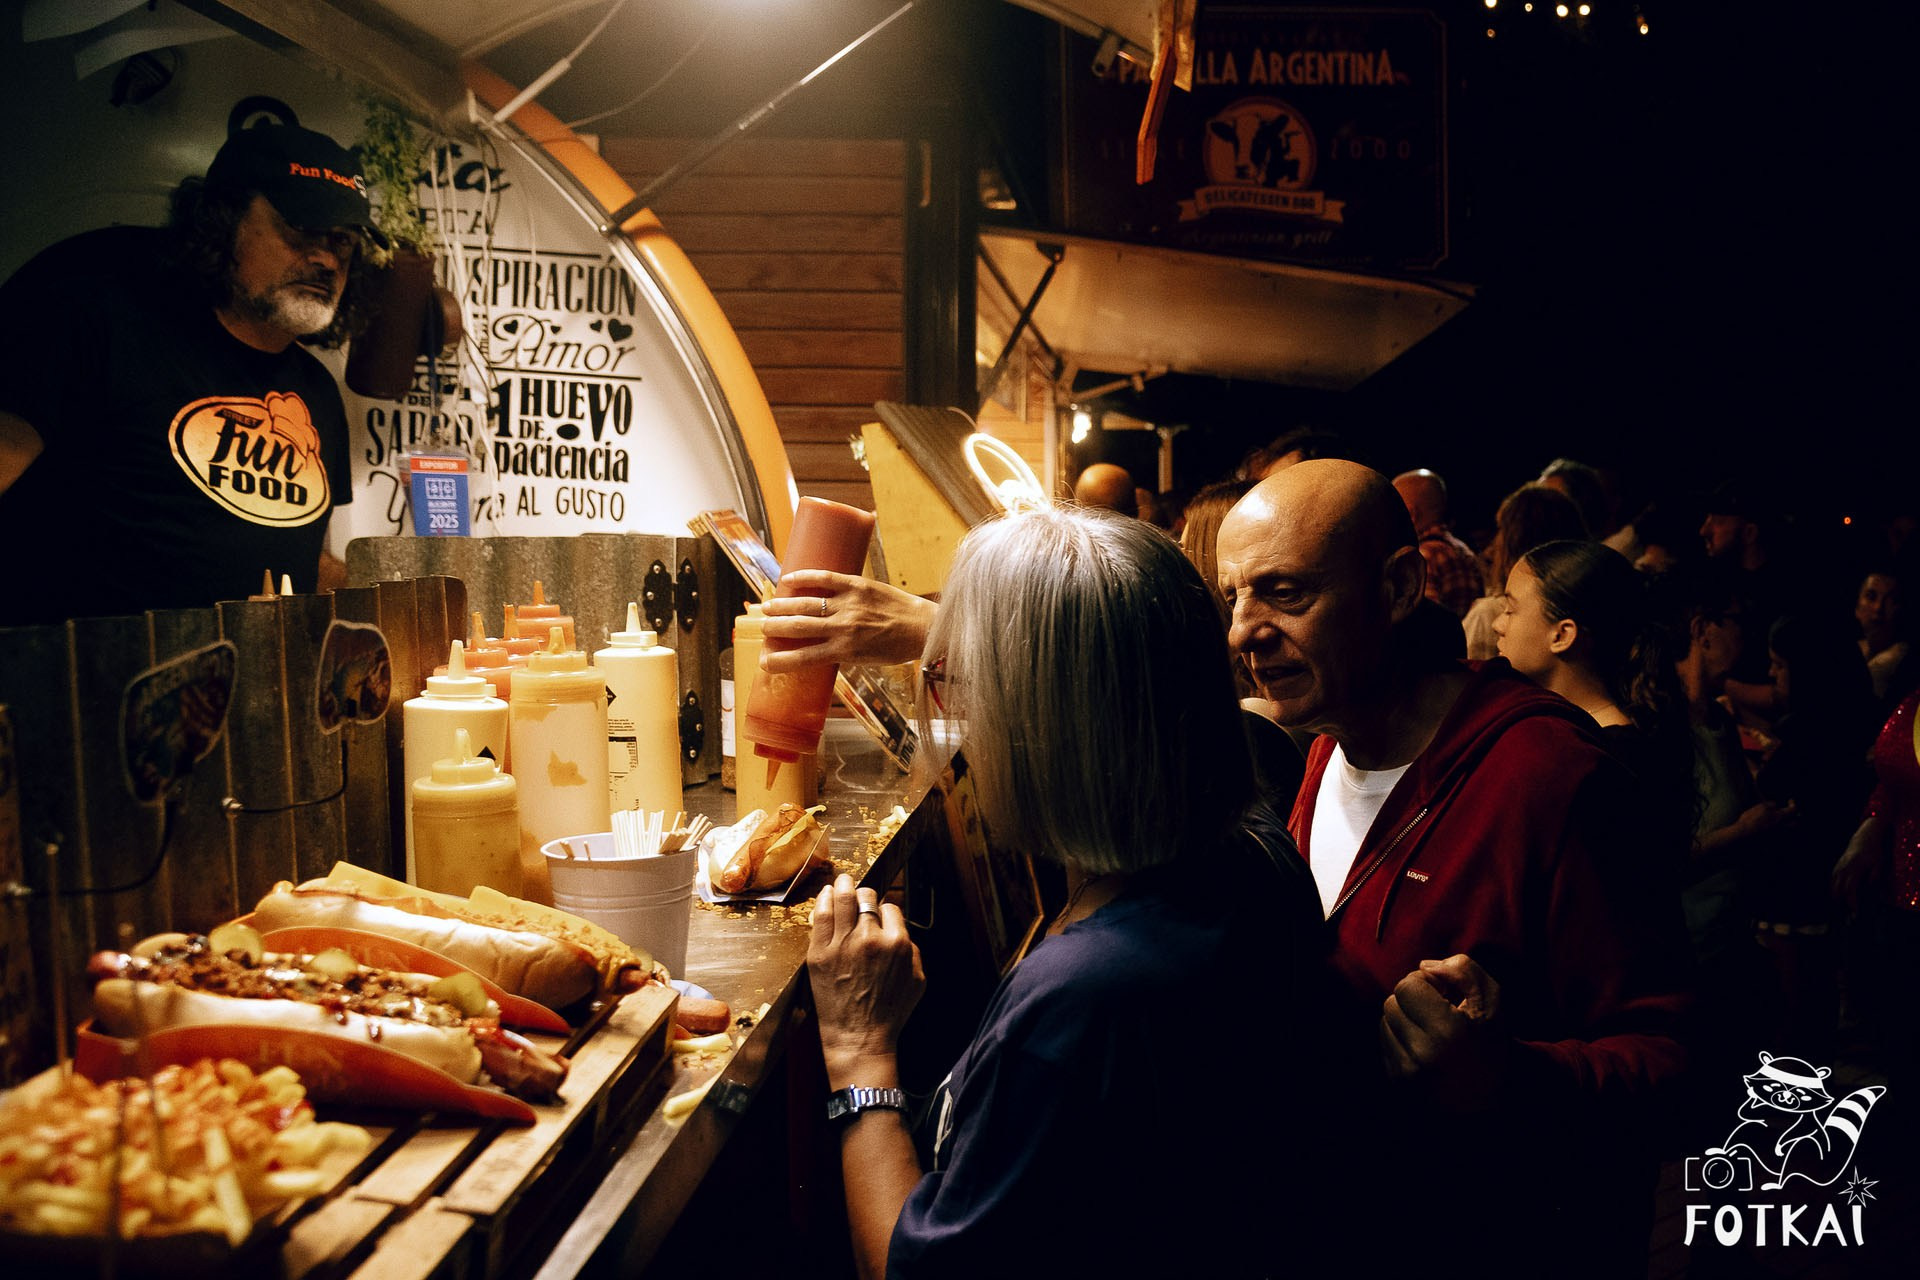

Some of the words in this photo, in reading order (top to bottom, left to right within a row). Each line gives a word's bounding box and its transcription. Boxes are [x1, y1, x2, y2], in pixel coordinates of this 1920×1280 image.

[1249, 48, 1396, 86] ARGENTINA
[289, 162, 320, 178] Fun
[519, 377, 633, 442] HUEVO
[208, 408, 303, 480] Fun
[518, 418, 545, 440] DE
[494, 436, 629, 482] paciencia
[208, 463, 307, 506] FOOD
[429, 513, 459, 529] 2025
[516, 486, 542, 516] AL
[556, 486, 625, 522] GUSTO
